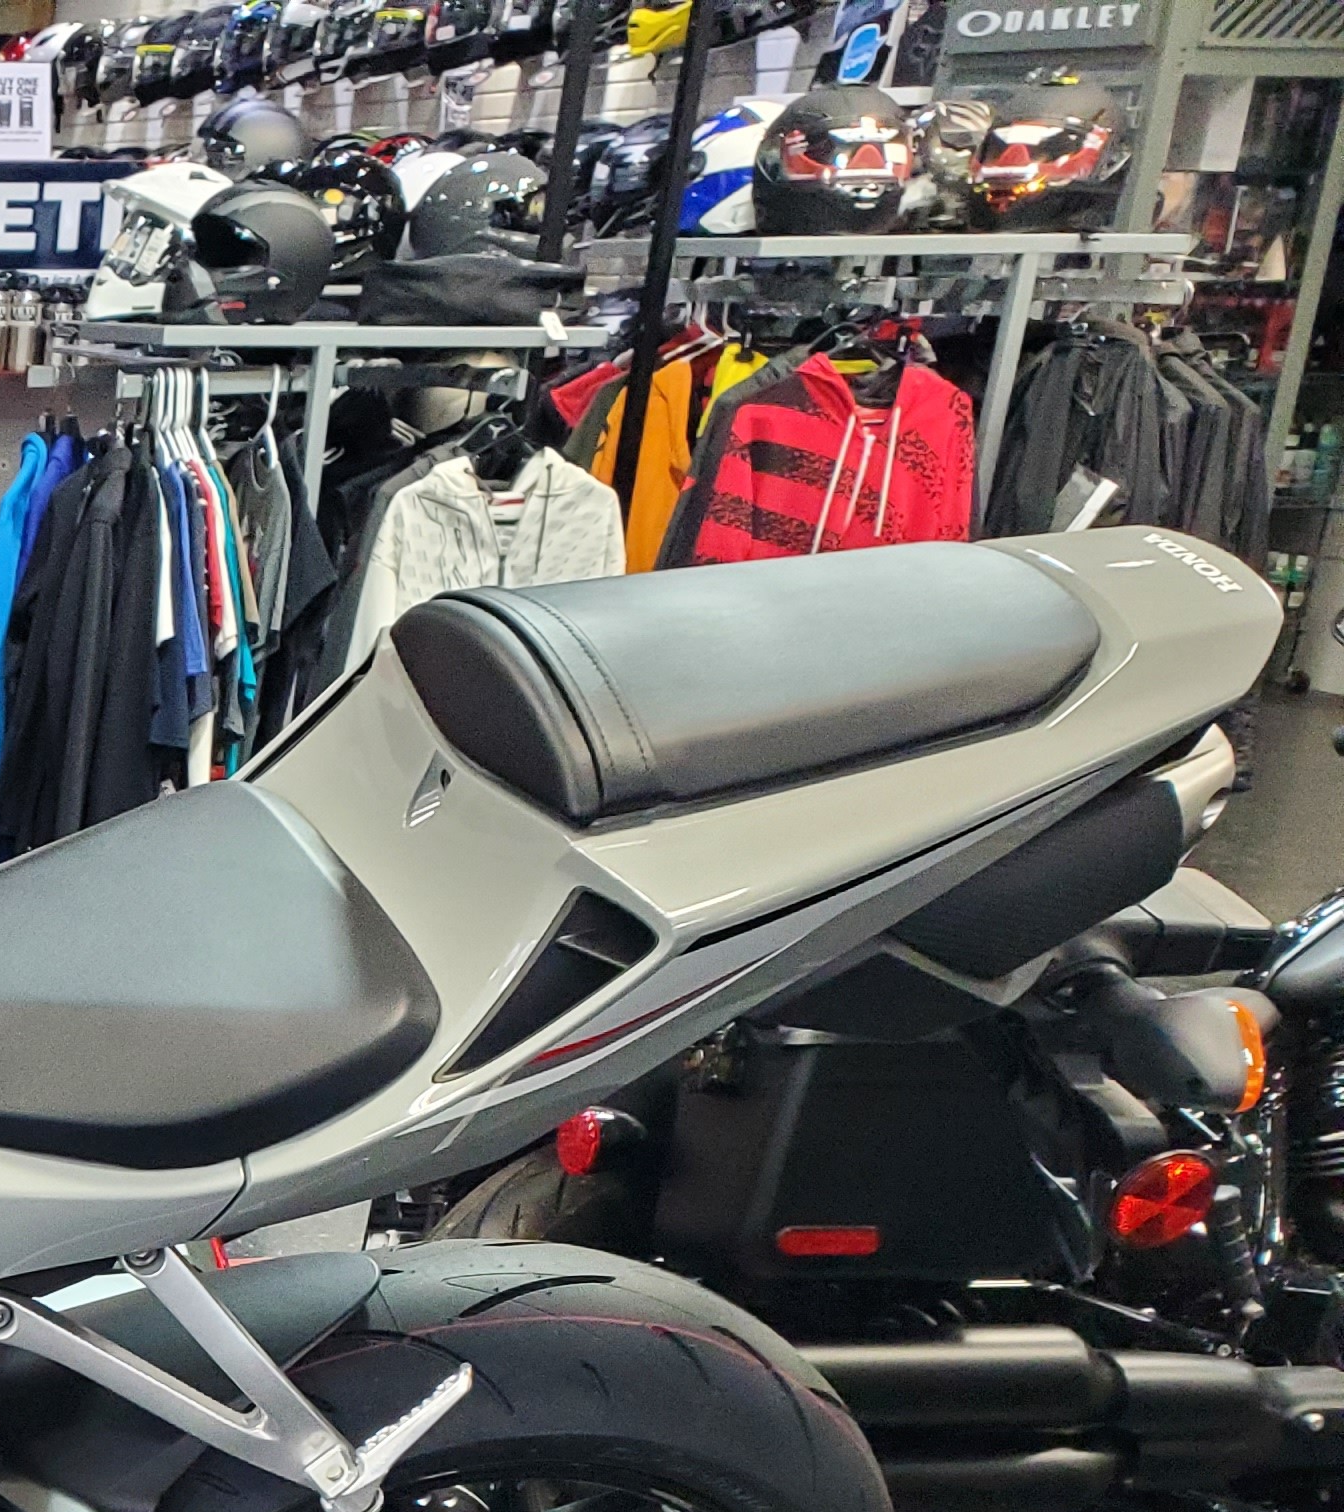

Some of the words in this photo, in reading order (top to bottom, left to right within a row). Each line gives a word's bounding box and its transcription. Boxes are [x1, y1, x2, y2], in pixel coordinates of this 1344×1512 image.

[17, 77, 38, 86] ONE
[17, 86, 38, 96] ONE
[1142, 533, 1243, 593] HONDA
